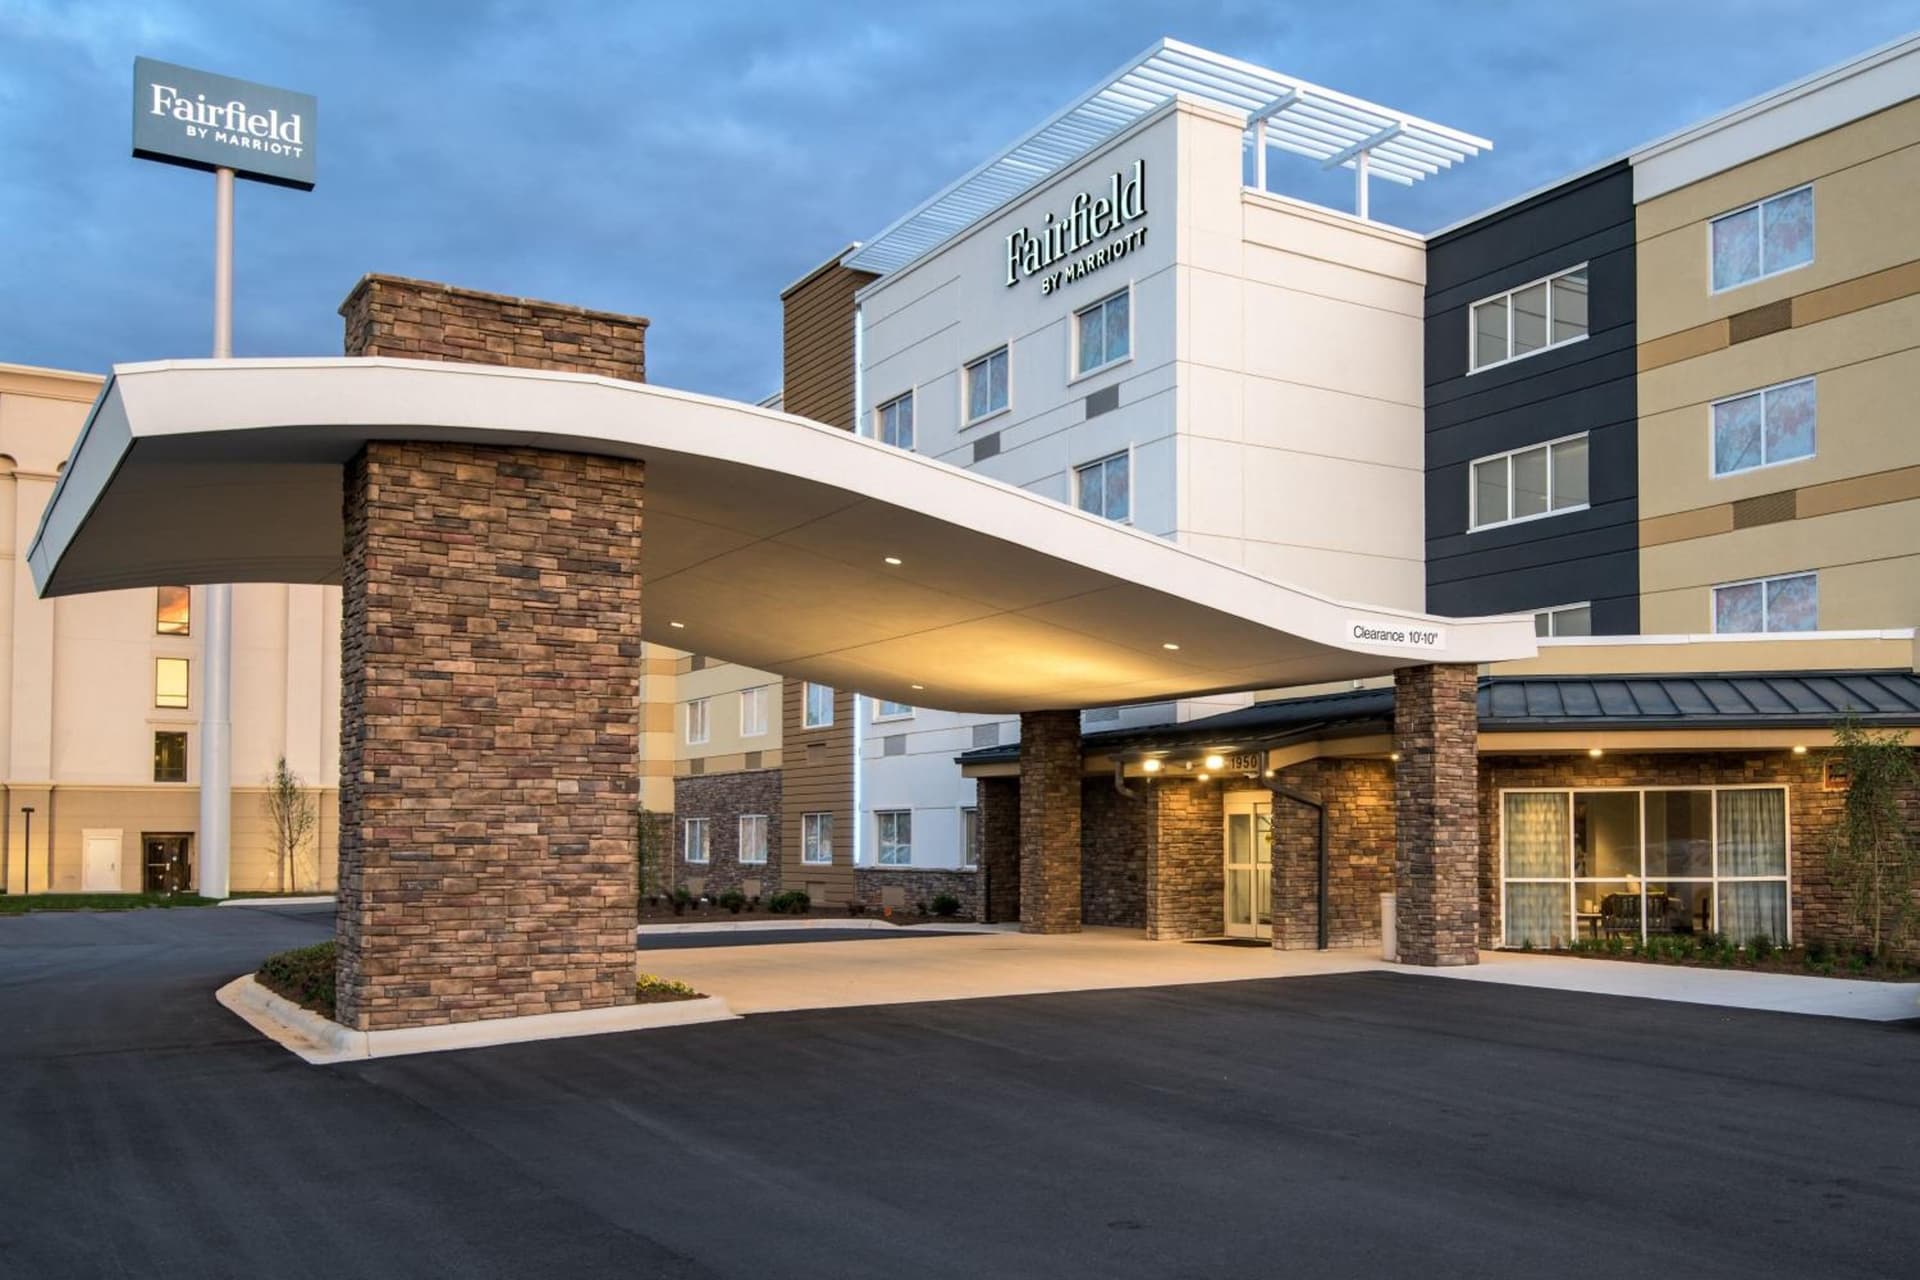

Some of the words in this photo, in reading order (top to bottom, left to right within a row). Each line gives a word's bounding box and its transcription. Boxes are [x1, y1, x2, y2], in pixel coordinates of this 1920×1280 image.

[151, 84, 303, 145] Fairfield
[186, 125, 208, 139] BY
[215, 131, 303, 158] MARRIOTT
[1005, 159, 1147, 287] Fairfield
[1042, 271, 1062, 295] BY
[1065, 227, 1147, 283] MARRIOTT
[1353, 625, 1405, 642] Clearance
[1231, 754, 1257, 769] 1950
